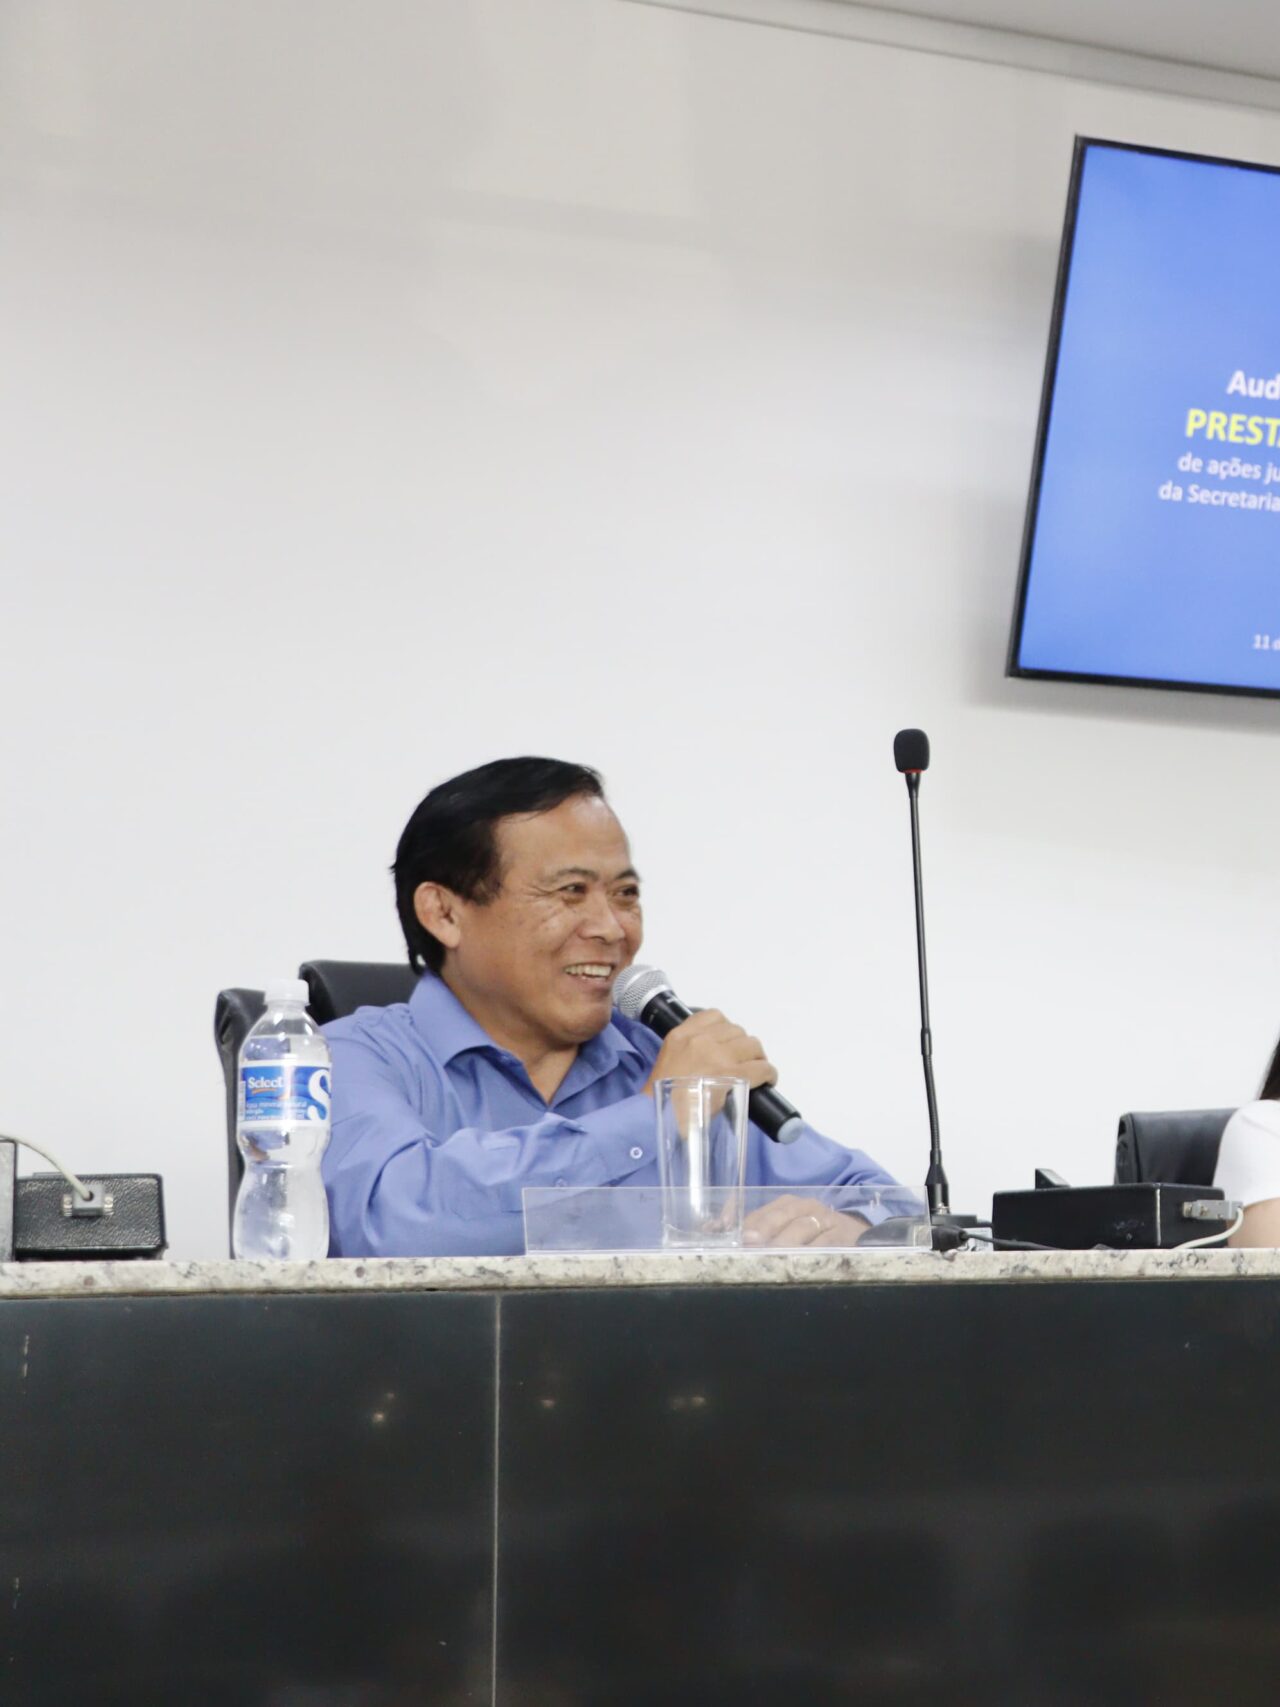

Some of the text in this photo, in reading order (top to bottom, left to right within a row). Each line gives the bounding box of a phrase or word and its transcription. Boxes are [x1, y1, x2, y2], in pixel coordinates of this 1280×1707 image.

[1177, 453, 1203, 473] de
[1207, 457, 1261, 482] ações
[1157, 480, 1183, 502] da
[1253, 634, 1270, 650] 11
[247, 1076, 285, 1089] Select
